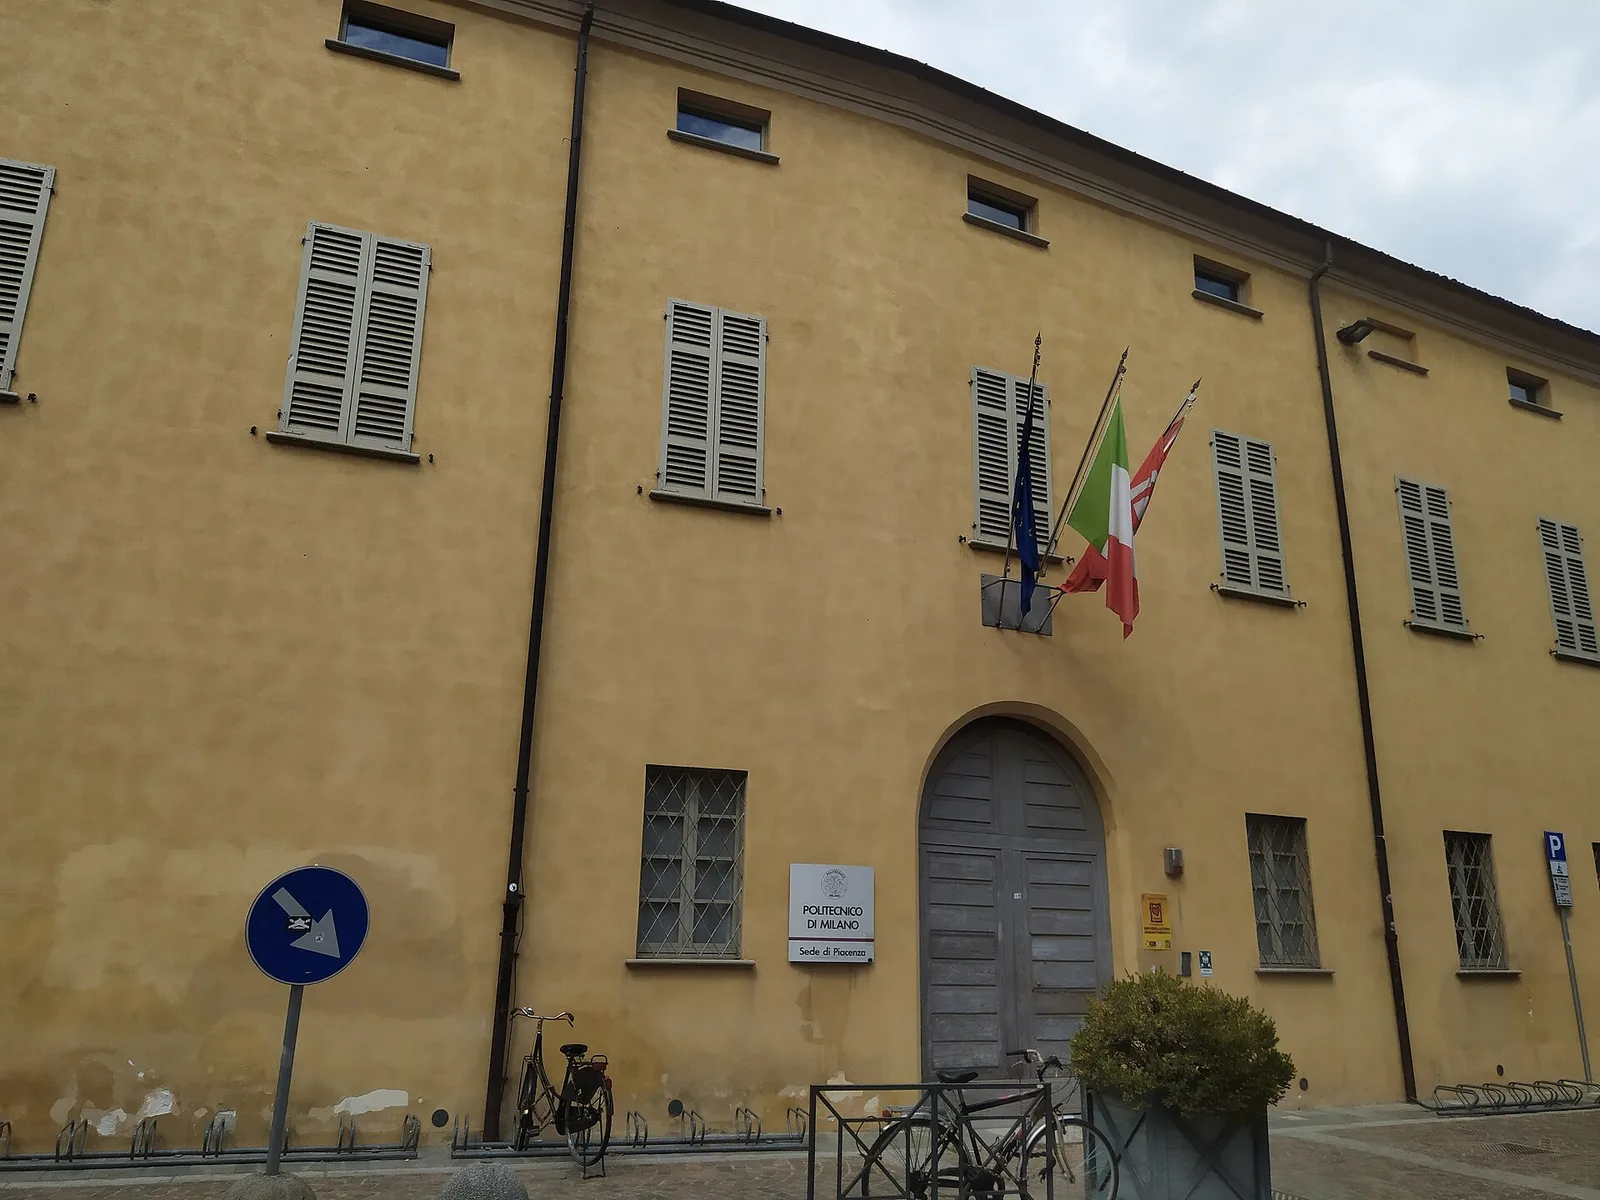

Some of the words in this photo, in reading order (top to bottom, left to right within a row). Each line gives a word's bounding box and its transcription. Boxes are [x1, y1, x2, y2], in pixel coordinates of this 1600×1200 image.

[1549, 834, 1562, 858] P
[803, 905, 863, 916] POLITECNICO
[807, 919, 817, 929] DI
[820, 919, 859, 930] MILANO
[799, 947, 820, 956] Sede
[823, 947, 831, 956] di
[833, 947, 866, 957] Piacenza
